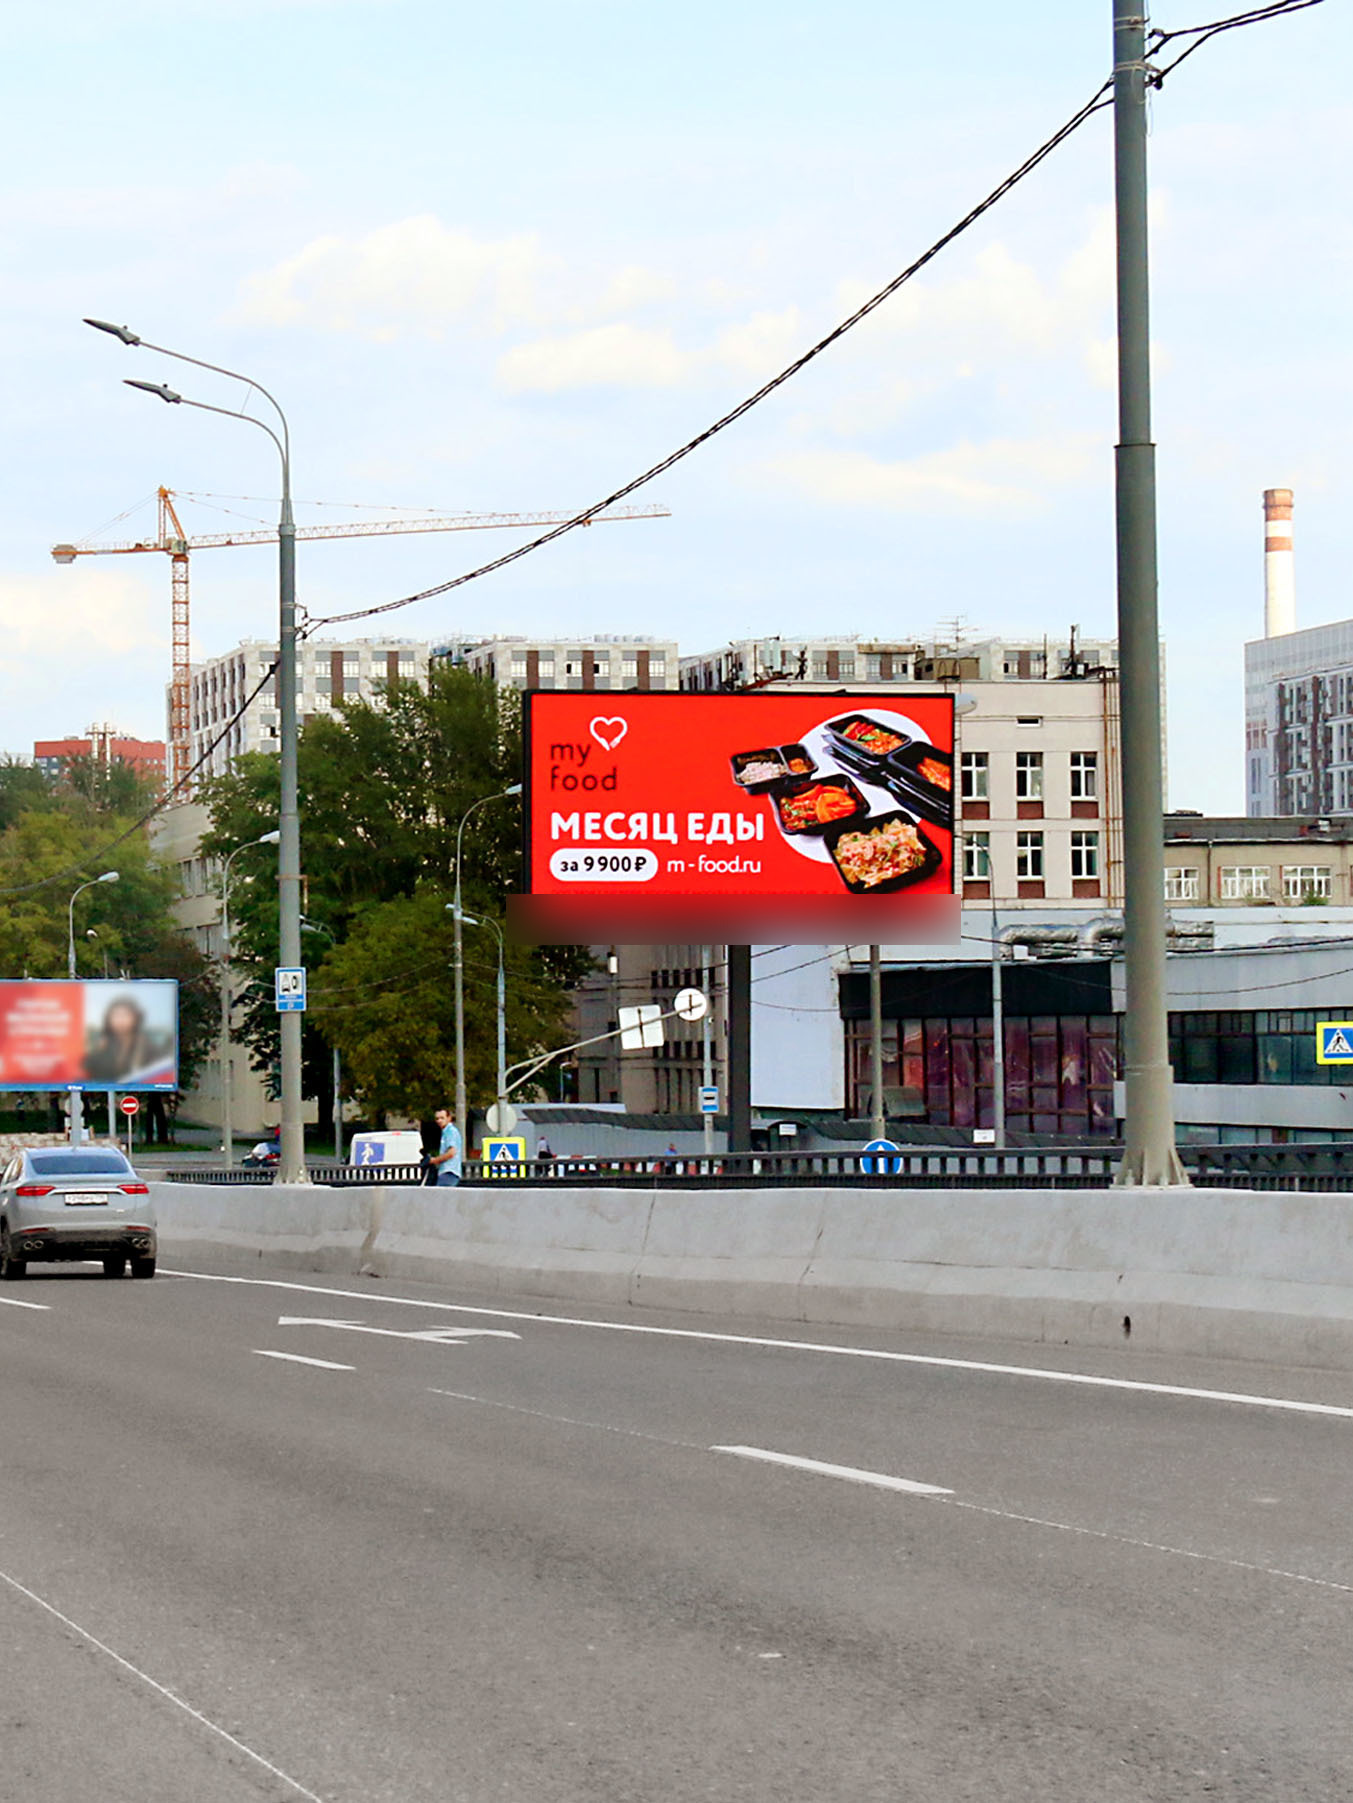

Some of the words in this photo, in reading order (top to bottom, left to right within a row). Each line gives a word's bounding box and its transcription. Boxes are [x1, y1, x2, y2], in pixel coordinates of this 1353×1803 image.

[550, 744, 591, 767] my
[550, 766, 617, 791] food
[551, 811, 679, 845] МЕСЯЦ
[687, 812, 765, 846] ЕДЫ
[560, 860, 579, 872] за
